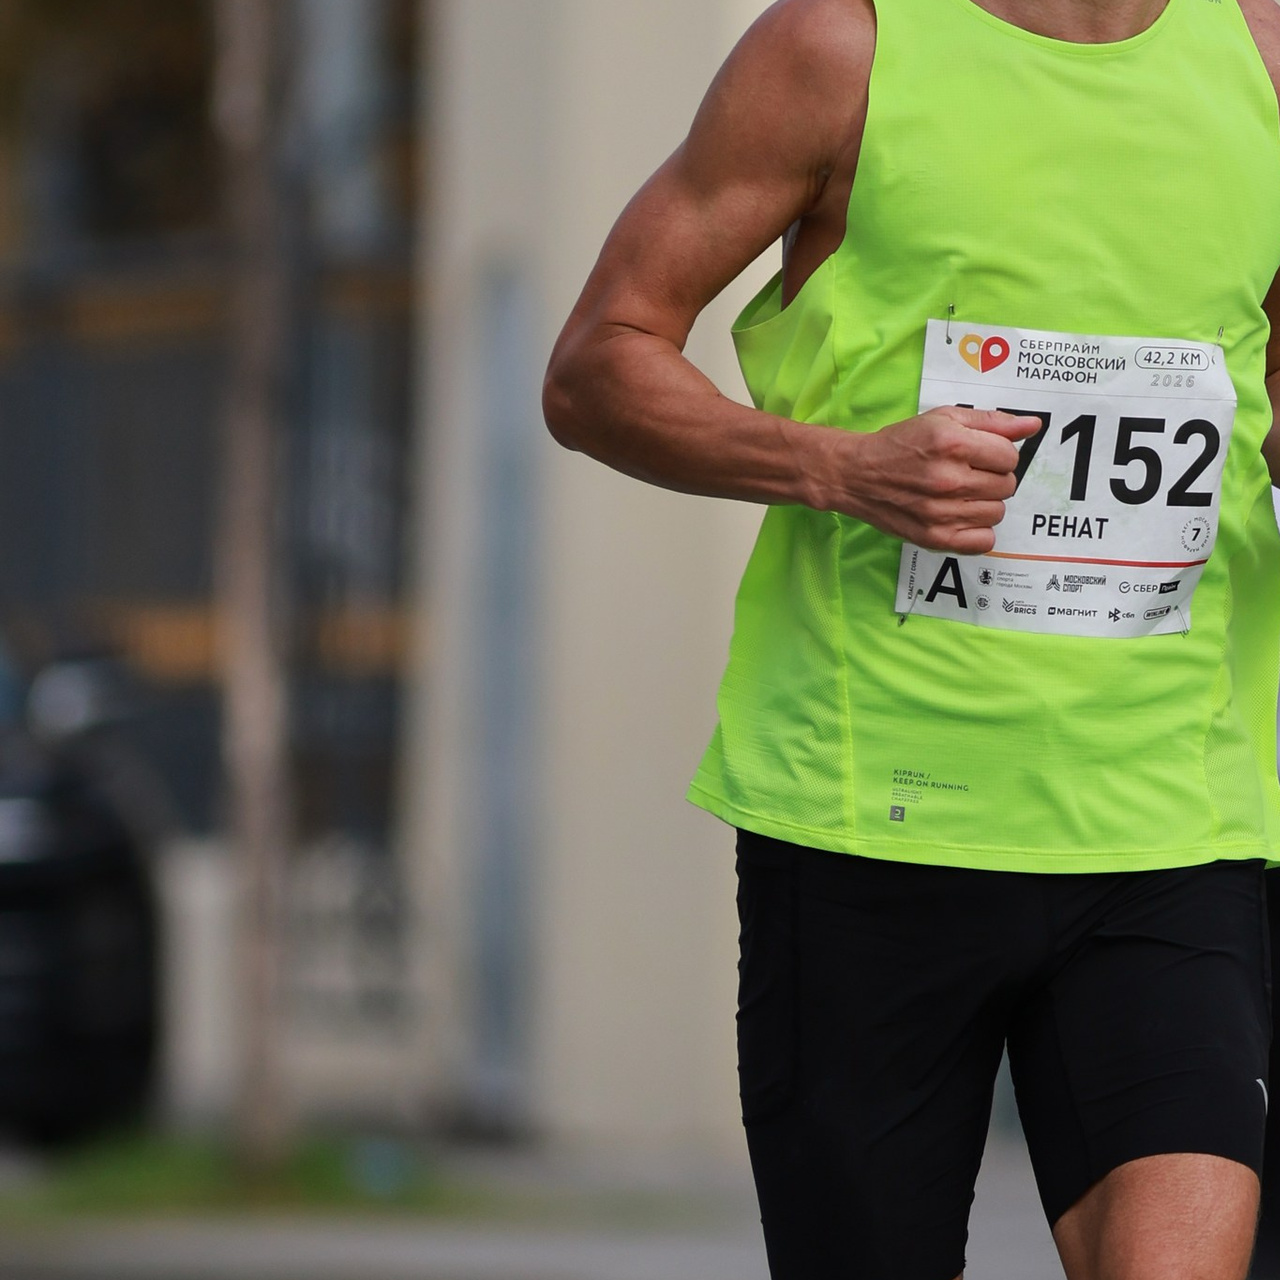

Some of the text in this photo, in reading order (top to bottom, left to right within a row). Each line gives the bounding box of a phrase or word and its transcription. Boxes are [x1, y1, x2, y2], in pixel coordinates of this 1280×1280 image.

[1020, 339, 1100, 354] СБЕРПРАЙМ
[1018, 351, 1126, 370] МОСКОВСКИЙ
[1143, 351, 1175, 366] 42,2
[1016, 366, 1098, 384] МАРАФОН
[1150, 374, 1195, 388] 2026
[954, 403, 1221, 507] 7152
[1031, 513, 1109, 540] РЕНАТ
[1192, 528, 1201, 541] 7
[1064, 574, 1107, 586] МОСКОВСКИЙ
[1063, 583, 1083, 593] СПОРТ
[1133, 584, 1158, 593] СБЕР
[1014, 606, 1037, 615] BRICS
[893, 769, 925, 779] KIPRUN
[893, 777, 914, 785] KEEP
[930, 781, 969, 792] RUNNING
